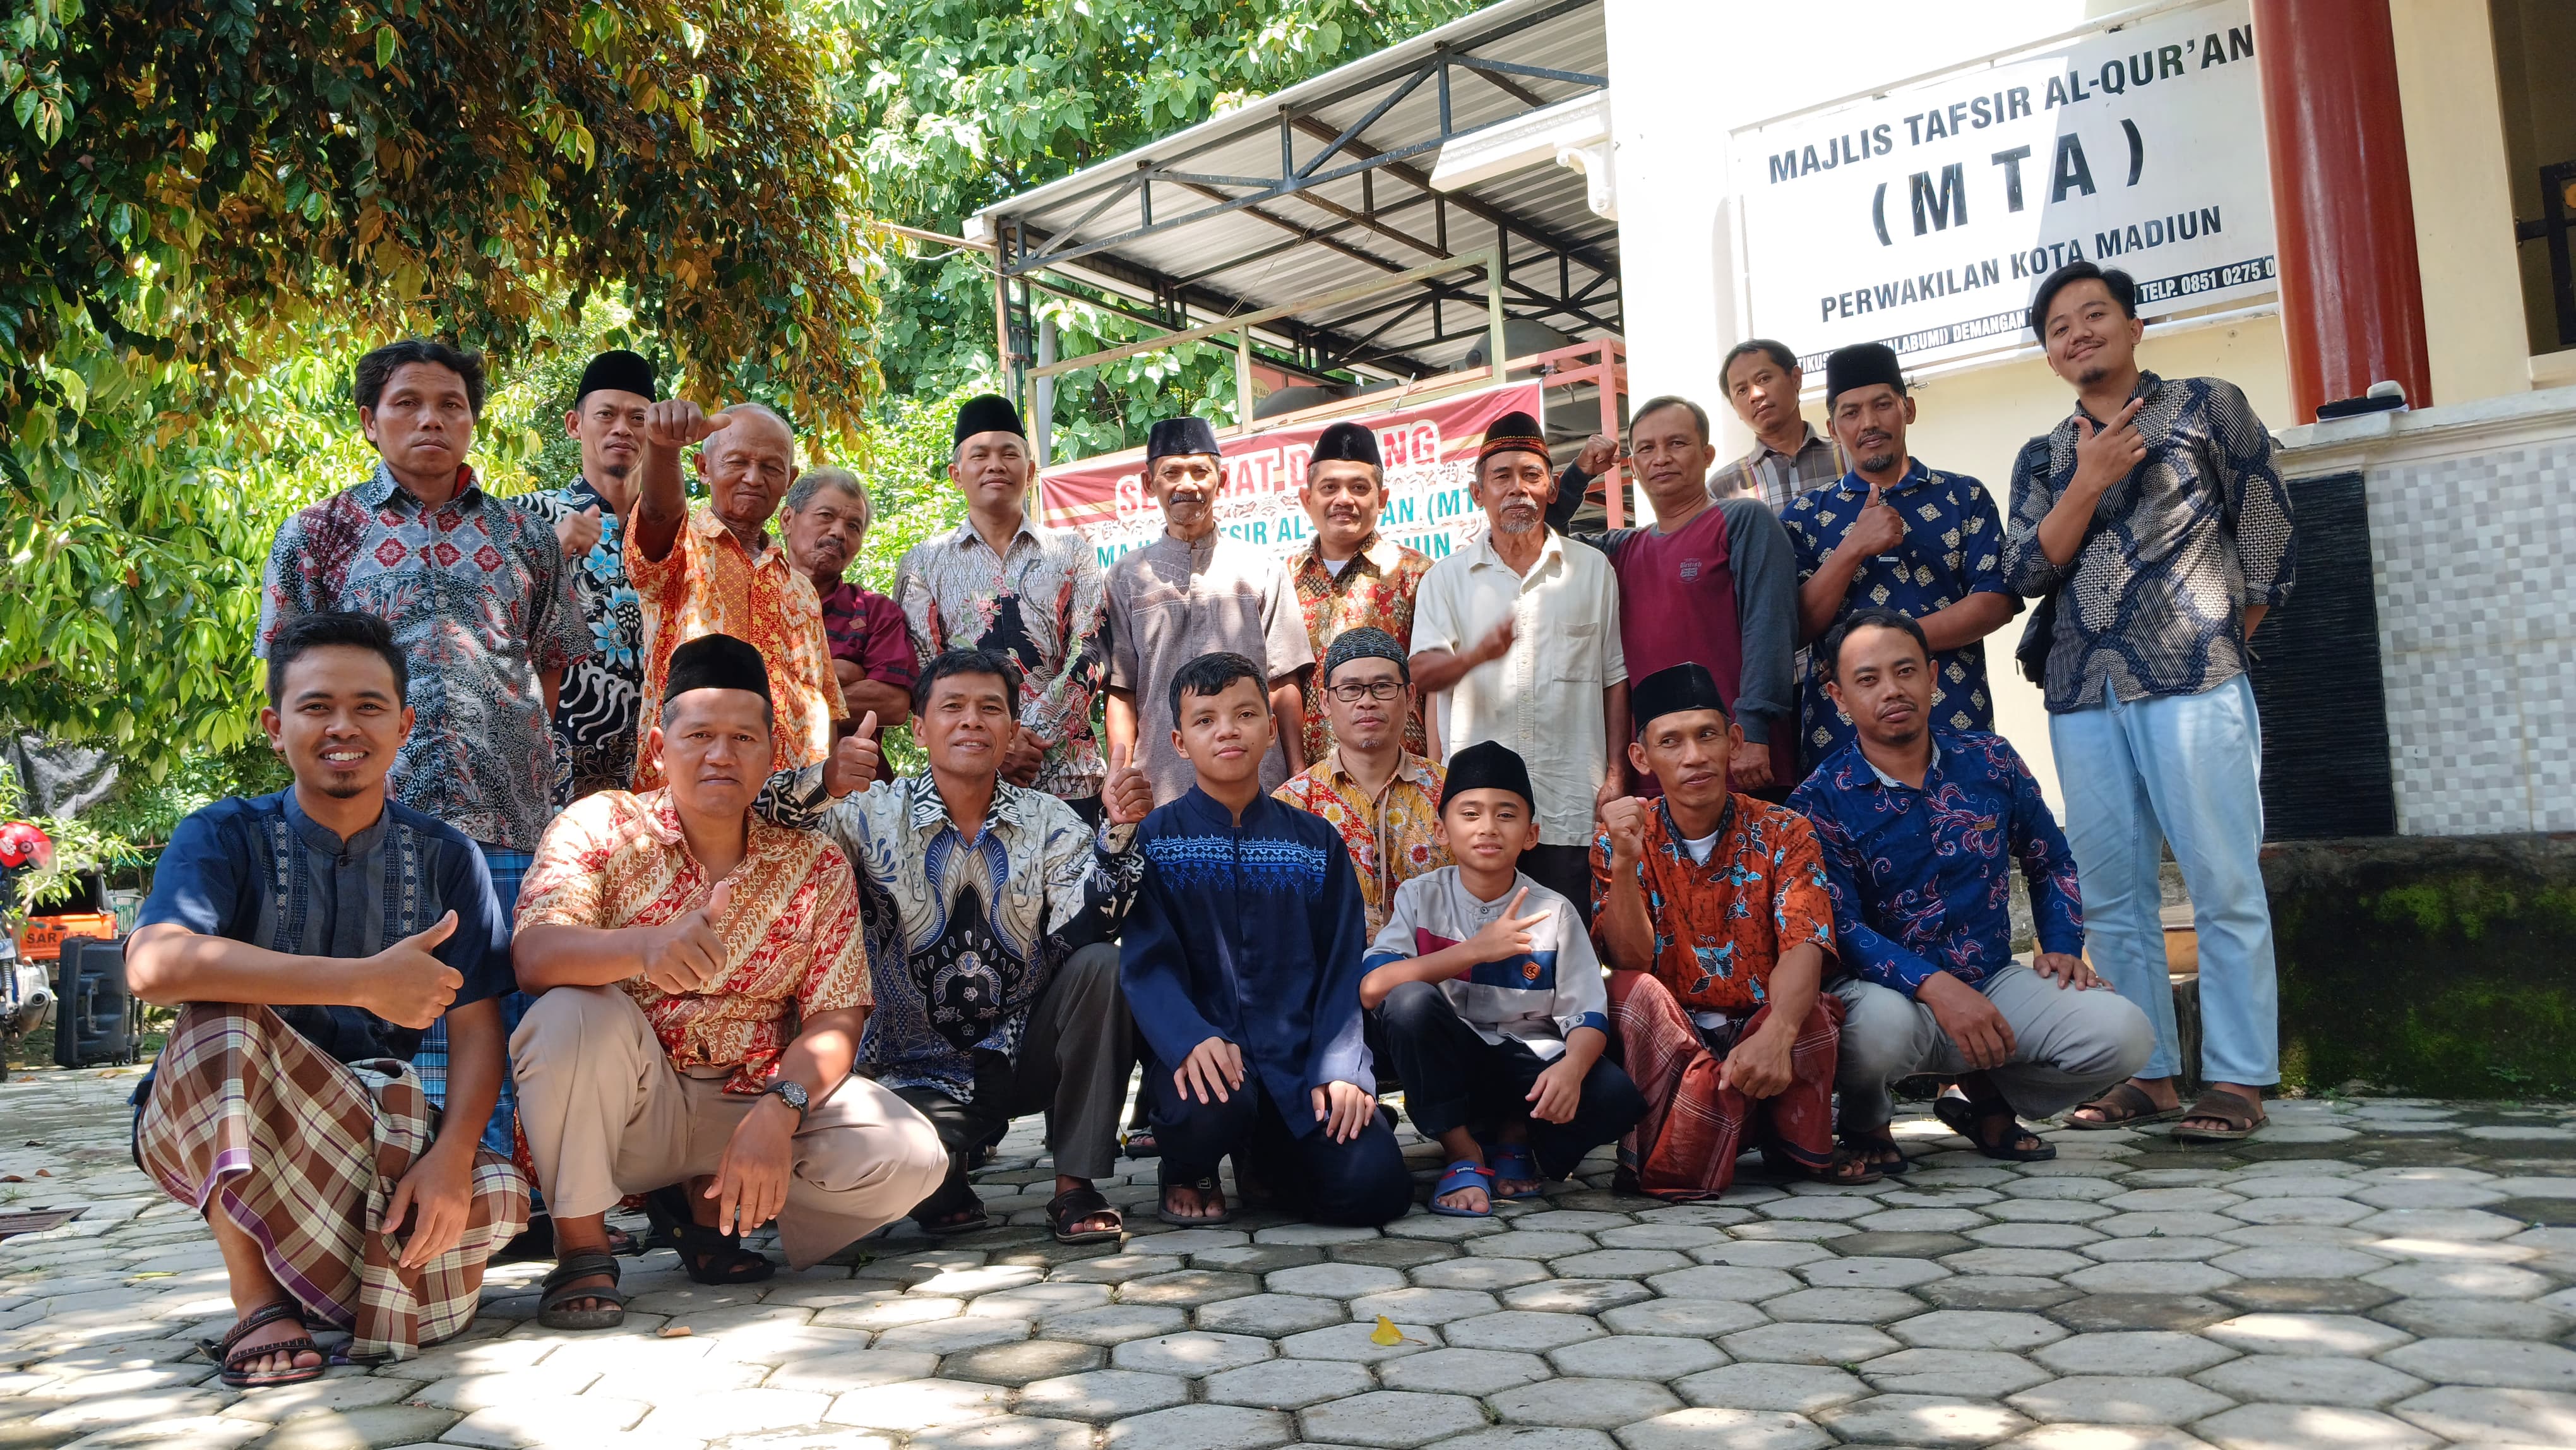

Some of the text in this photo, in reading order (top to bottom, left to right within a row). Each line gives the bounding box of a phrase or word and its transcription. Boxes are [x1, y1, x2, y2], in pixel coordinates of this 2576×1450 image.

[1769, 23, 2255, 184] MAJLIS TAFSIR AL-QUR'AN
[1821, 205, 2222, 323] PERWAKILAN KOTA MADIUN
[1952, 310, 2026, 342] DEMANGAN
[2140, 279, 2178, 303] TELP.
[2181, 270, 2217, 294] 0851
[2222, 261, 2261, 286] 0275
[27, 932, 57, 944] SAR
